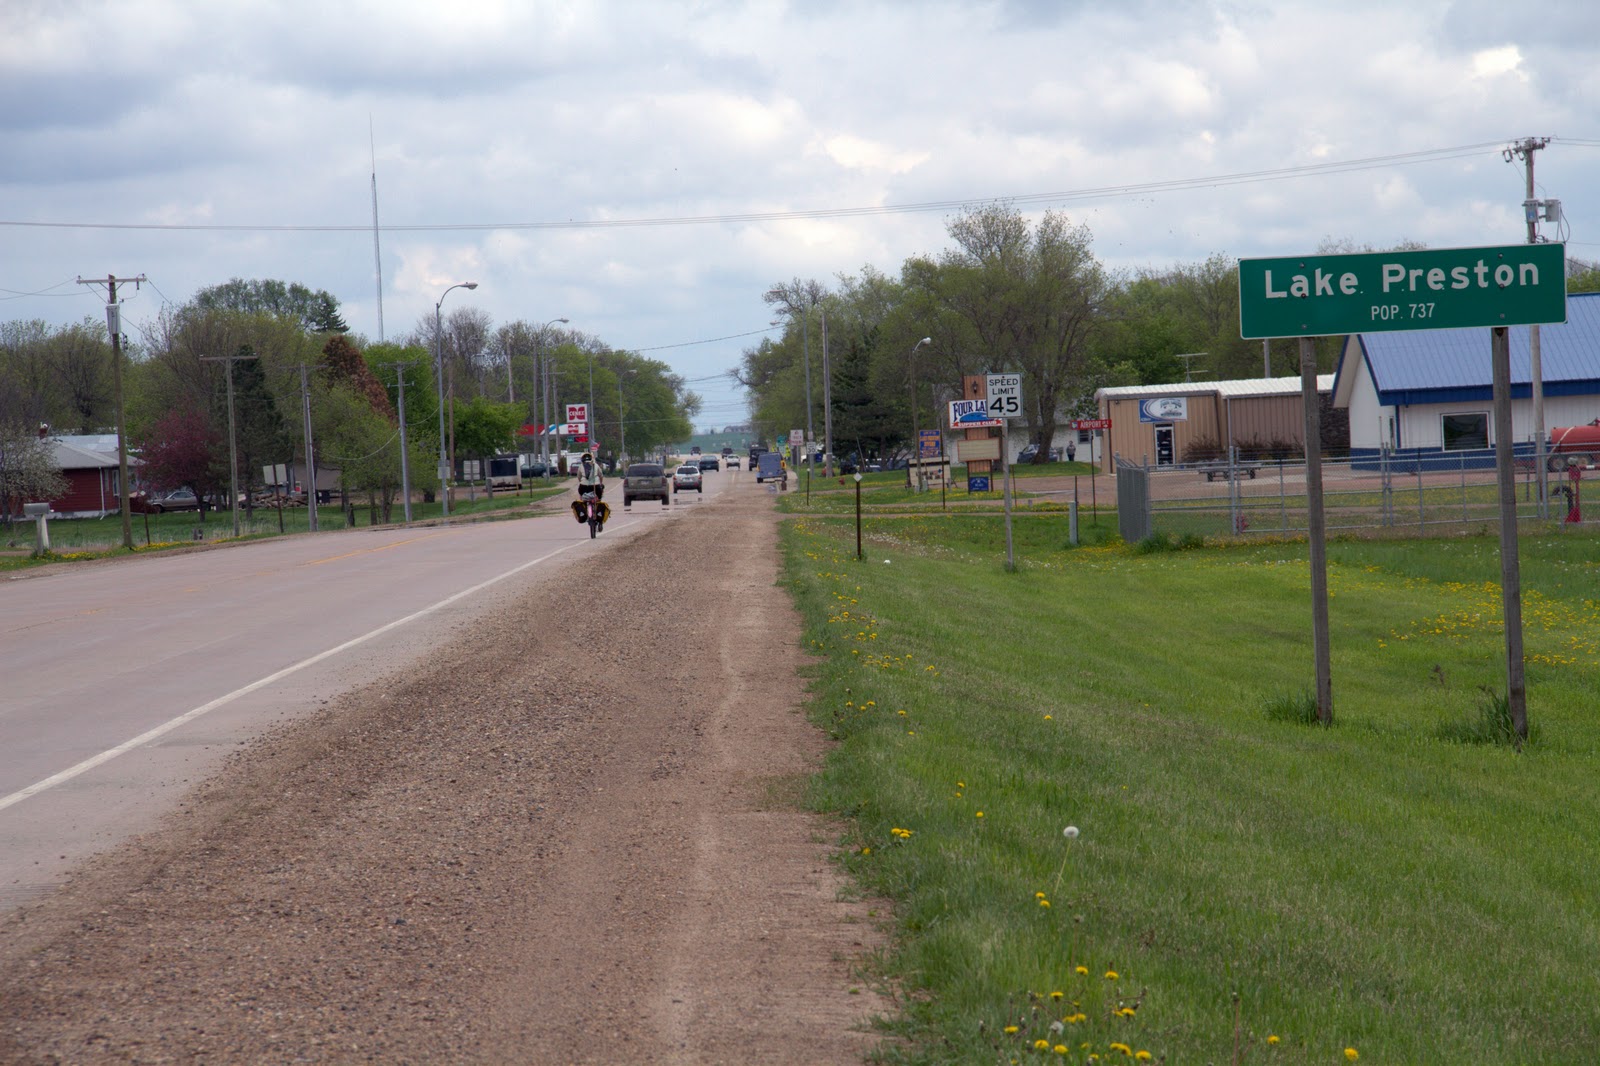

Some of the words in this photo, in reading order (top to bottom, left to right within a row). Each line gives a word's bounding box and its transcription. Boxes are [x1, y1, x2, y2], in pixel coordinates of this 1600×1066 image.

[1265, 267, 1359, 299] Lake
[1382, 259, 1539, 293] Preston
[1408, 302, 1436, 319] 737
[953, 401, 974, 422] FOUR
[990, 397, 1018, 413] 45
[1080, 420, 1102, 429] AIRPORT
